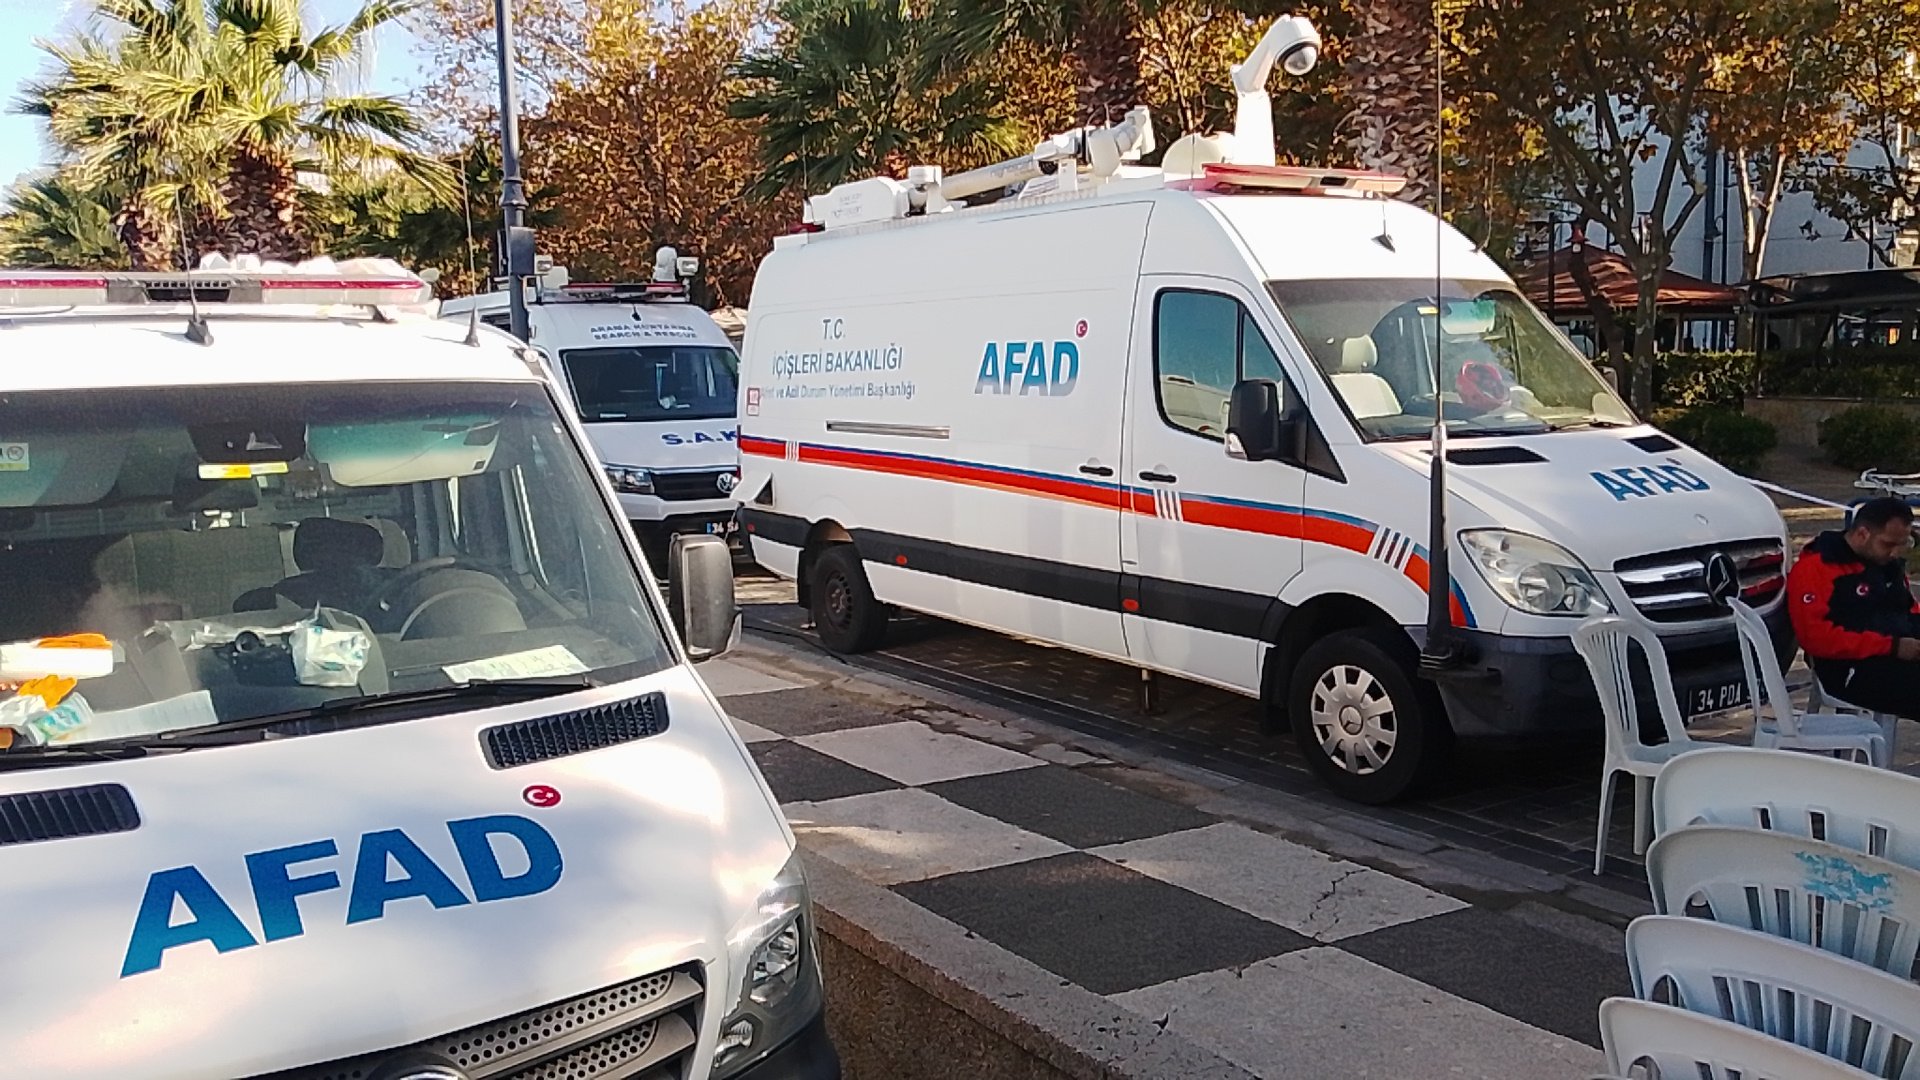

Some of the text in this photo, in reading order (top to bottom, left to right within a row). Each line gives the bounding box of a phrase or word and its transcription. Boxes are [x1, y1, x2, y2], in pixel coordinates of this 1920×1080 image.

[594, 332, 641, 340] SEARCH
[823, 319, 846, 340] T.C.
[825, 343, 903, 372] BAKANLIĞI
[974, 341, 1079, 397] AFAD
[1589, 464, 1711, 501] AFAD
[1697, 688, 1714, 711] 34
[1719, 682, 1742, 708] PDA
[120, 814, 563, 979] AFAD
